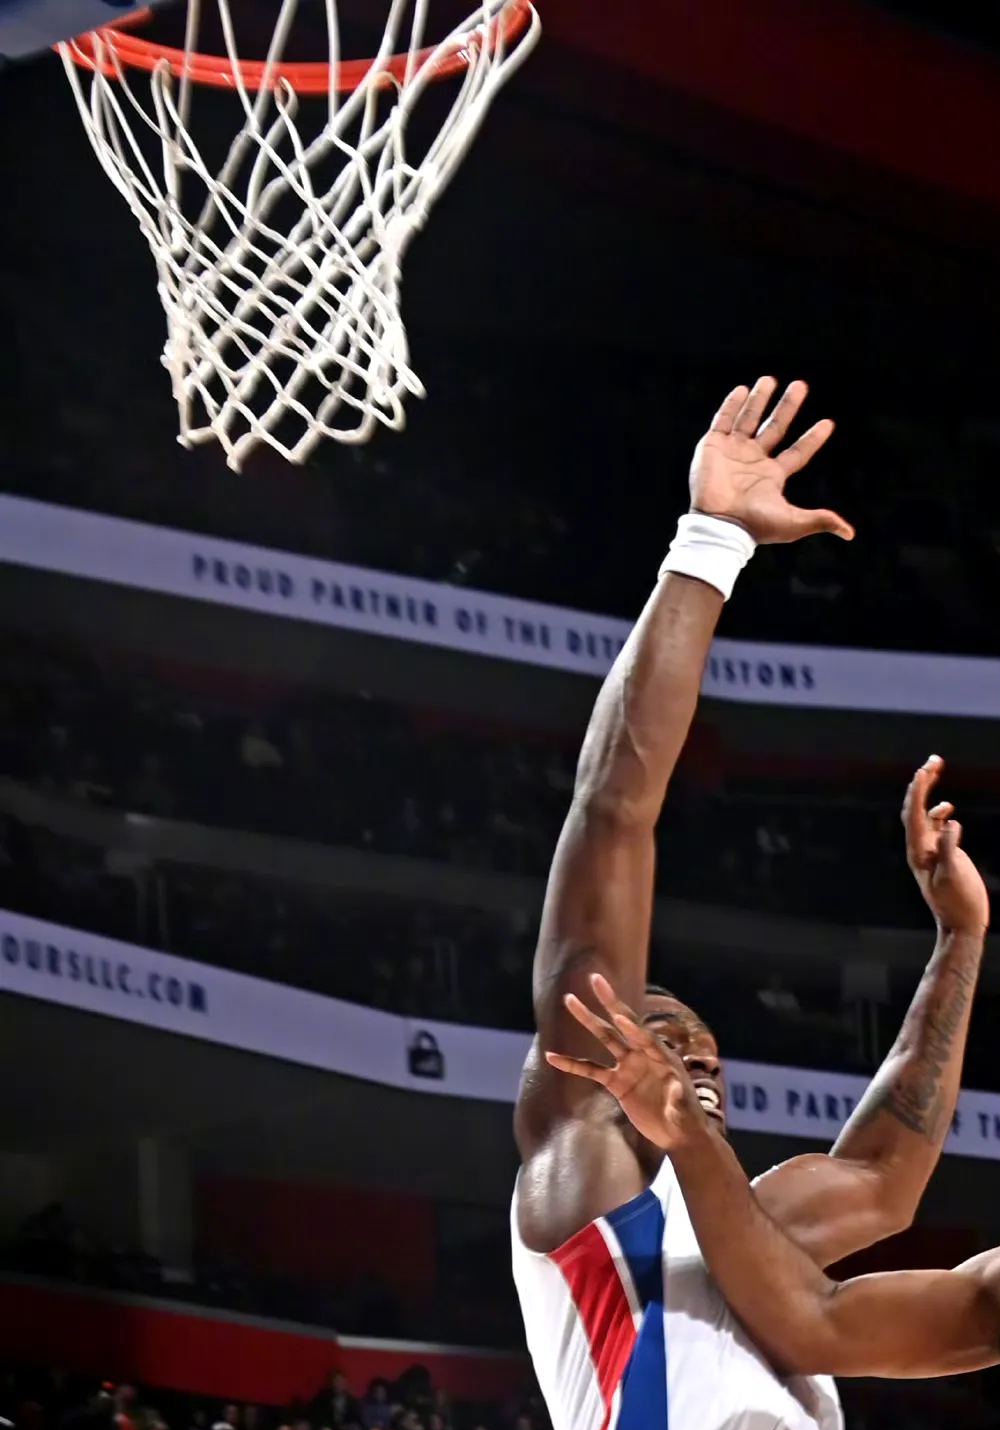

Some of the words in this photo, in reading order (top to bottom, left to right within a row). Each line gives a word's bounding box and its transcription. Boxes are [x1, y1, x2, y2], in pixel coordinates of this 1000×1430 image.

[193, 553, 294, 600] PROUD
[311, 577, 438, 627] PARTNER
[454, 606, 488, 636] OF
[504, 616, 551, 649] THE
